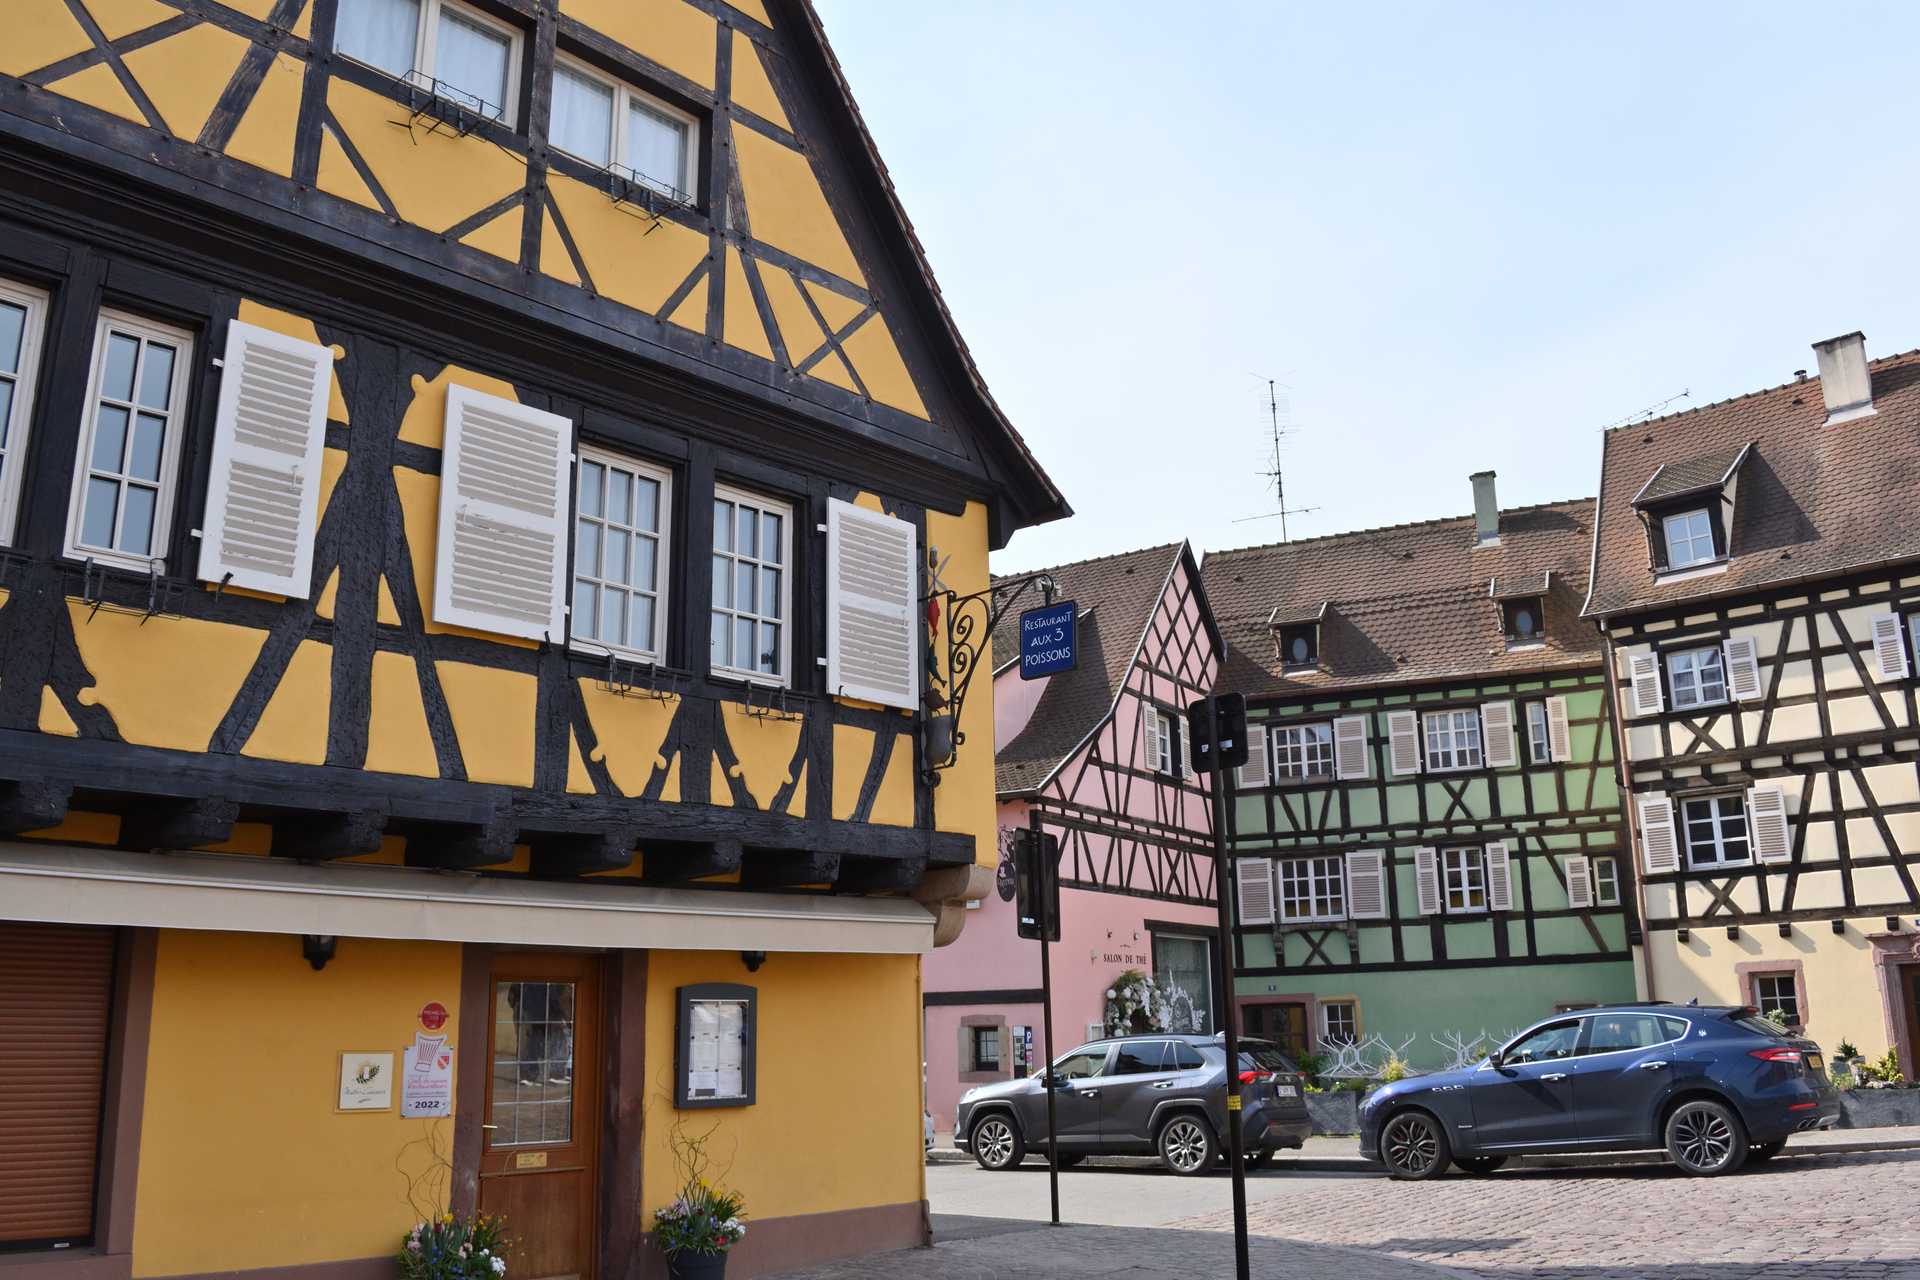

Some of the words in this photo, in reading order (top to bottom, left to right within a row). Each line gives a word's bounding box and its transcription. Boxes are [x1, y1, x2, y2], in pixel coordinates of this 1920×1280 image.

[1031, 634, 1051, 647] AUX
[1055, 628, 1064, 641] 3
[1026, 647, 1070, 667] POISSONS
[1104, 954, 1122, 962] SALON
[1126, 954, 1132, 964] DE
[416, 1100, 440, 1108] 2022
